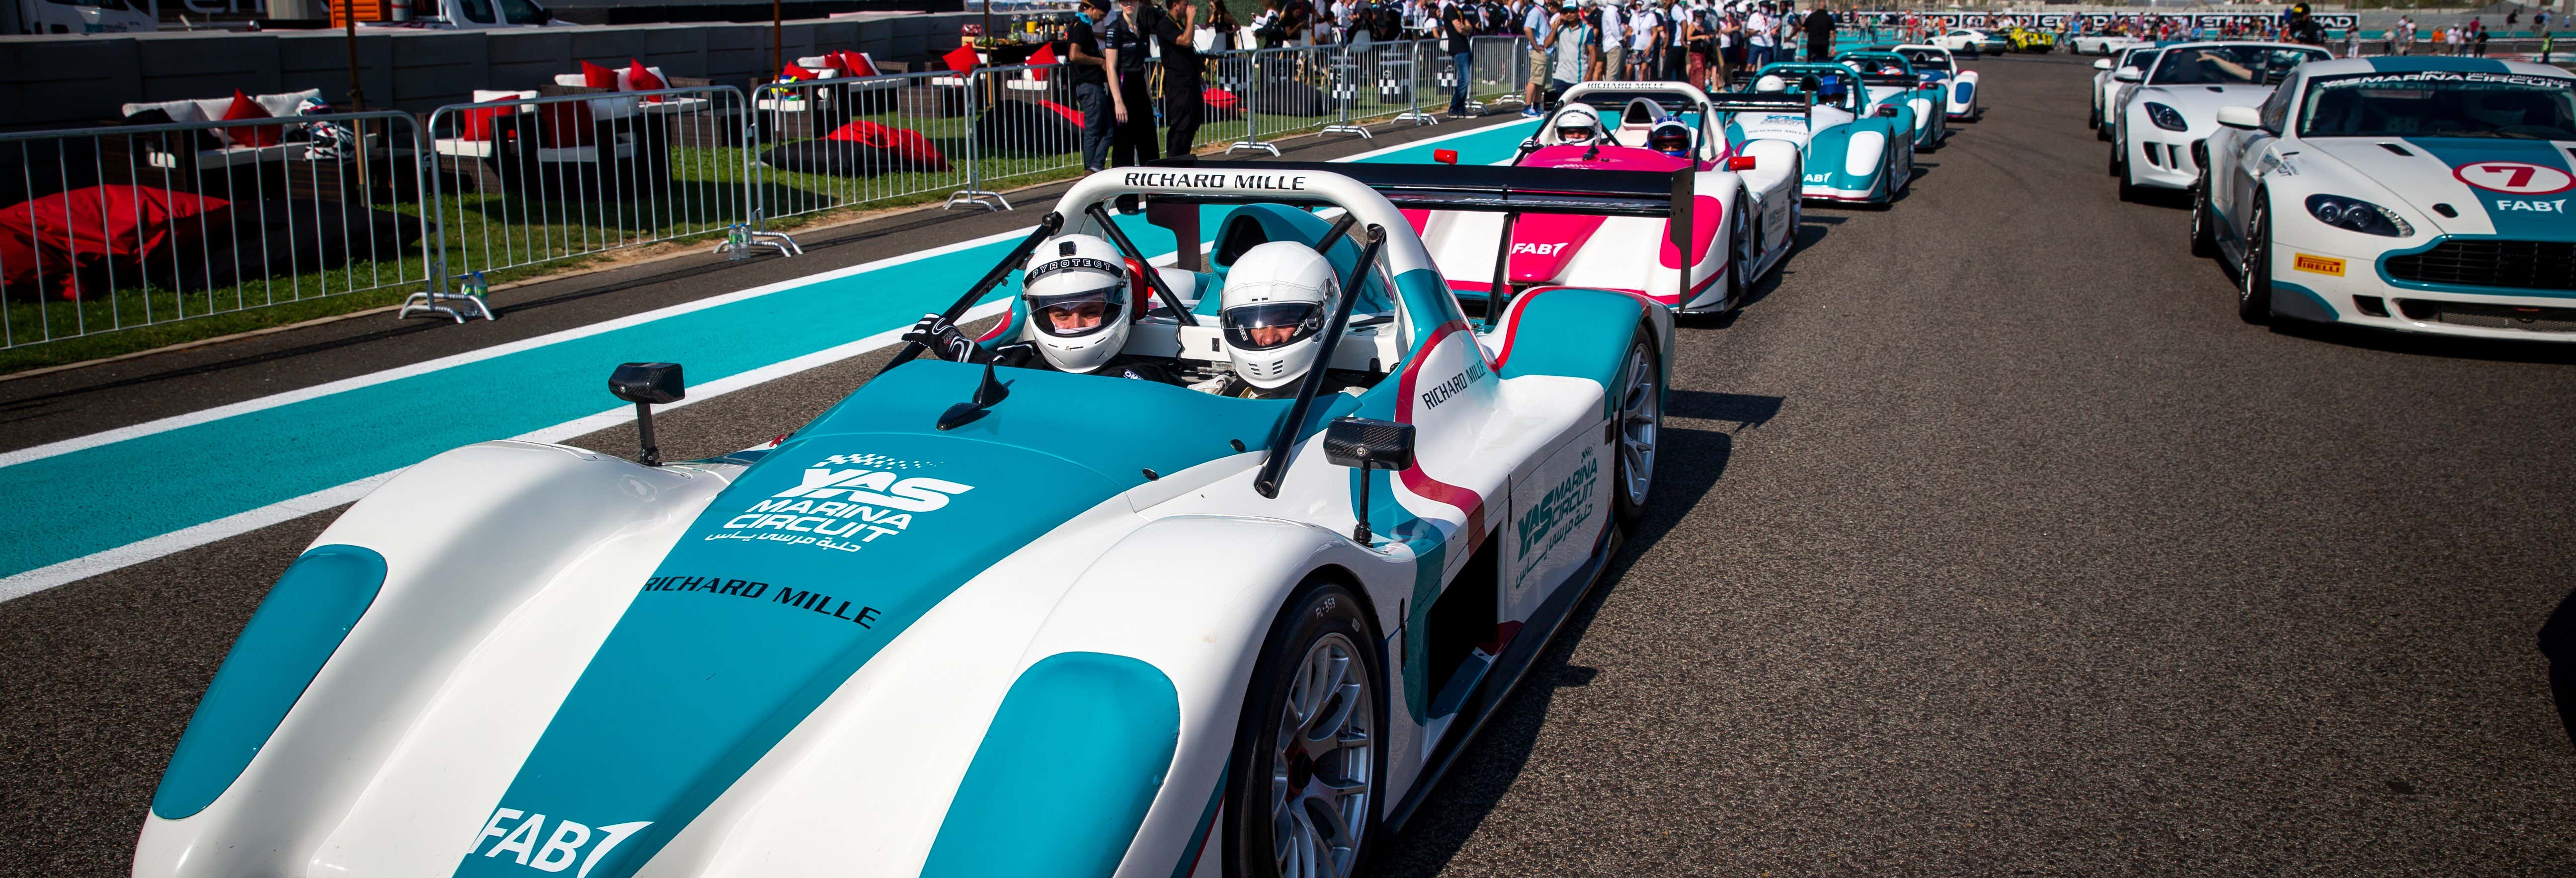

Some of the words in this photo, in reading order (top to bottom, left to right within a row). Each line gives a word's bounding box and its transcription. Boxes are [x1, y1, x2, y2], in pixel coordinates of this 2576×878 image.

[1125, 172, 1225, 188] RICHARD
[1235, 175, 1306, 190] MILLE
[2481, 166, 2536, 187] 7
[1033, 259, 1111, 278] PYROTECT
[2297, 256, 2340, 273] PIRELLI
[1422, 373, 1468, 410] RICHARD
[1465, 360, 1486, 385] MILLE
[770, 468, 975, 512] YAS
[1551, 477, 1597, 528] CIRCUIT
[745, 499, 912, 530] MARINA
[1518, 489, 1555, 563] YAS
[1554, 458, 1598, 505] MARINA
[723, 514, 899, 543] CIRCUIT
[644, 576, 769, 599] RICHARD
[772, 587, 882, 630] MILLE
